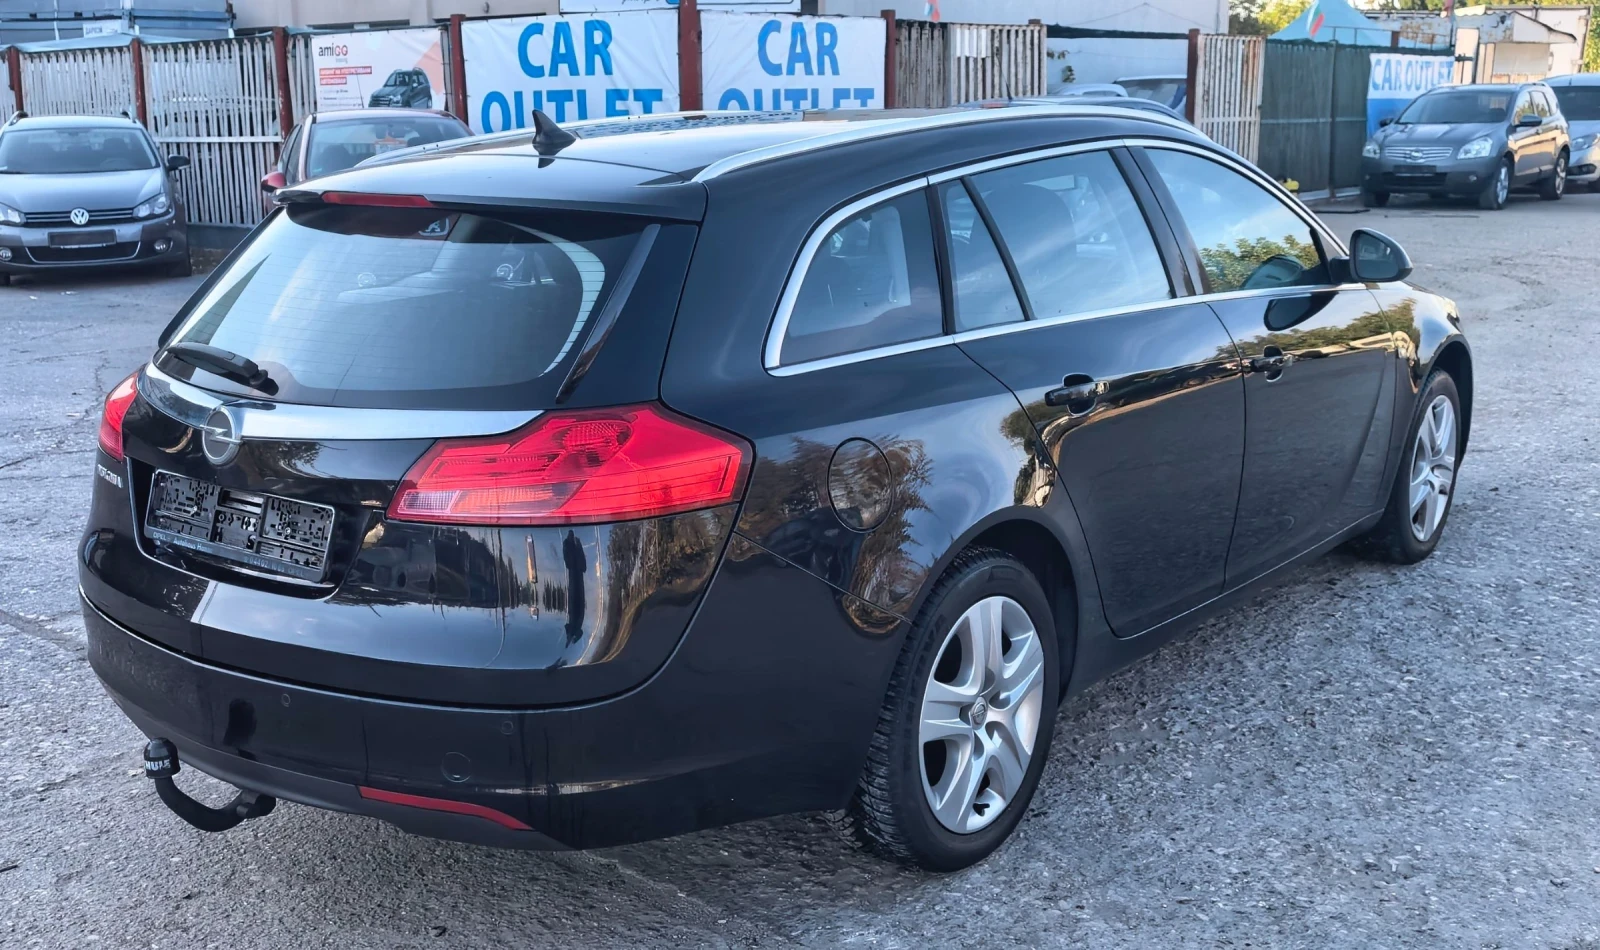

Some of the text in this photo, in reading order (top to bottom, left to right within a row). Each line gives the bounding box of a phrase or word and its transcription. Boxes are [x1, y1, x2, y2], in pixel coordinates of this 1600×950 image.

[518, 19, 614, 79] CAR
[758, 20, 841, 77] CAR
[1371, 58, 1402, 92] CAR
